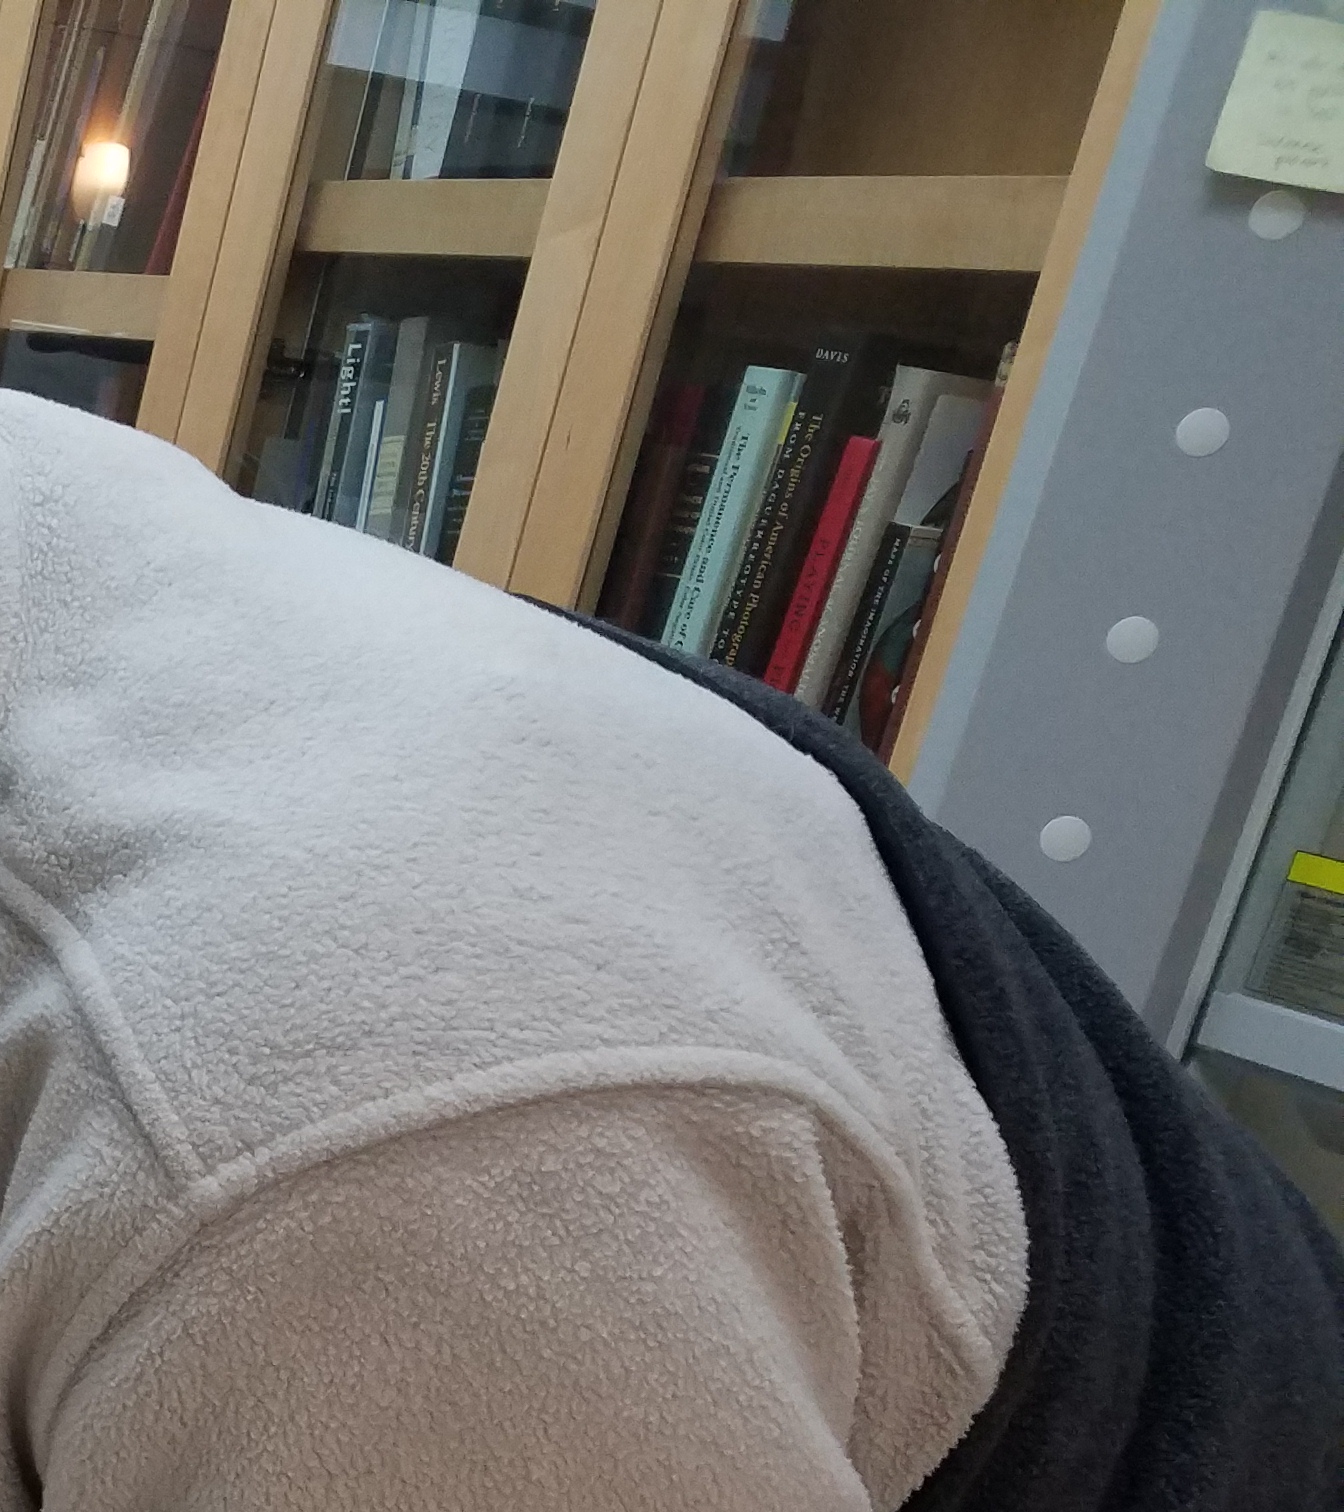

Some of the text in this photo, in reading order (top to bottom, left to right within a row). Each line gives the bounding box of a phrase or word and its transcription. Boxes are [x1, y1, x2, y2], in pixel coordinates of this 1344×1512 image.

[339, 343, 362, 414] Light!
[815, 348, 849, 363] DAVIS
[405, 358, 447, 552] Lewis The 20th Century
[803, 411, 824, 442] The
[780, 442, 812, 501] Origins
[676, 432, 750, 638] The Permanence and Care of
[716, 409, 805, 649] FROM DAGUERREOTYPE TO
[776, 501, 792, 519] of
[751, 520, 784, 590] American
[786, 536, 829, 634] PLAYING
[871, 584, 885, 606] THE
